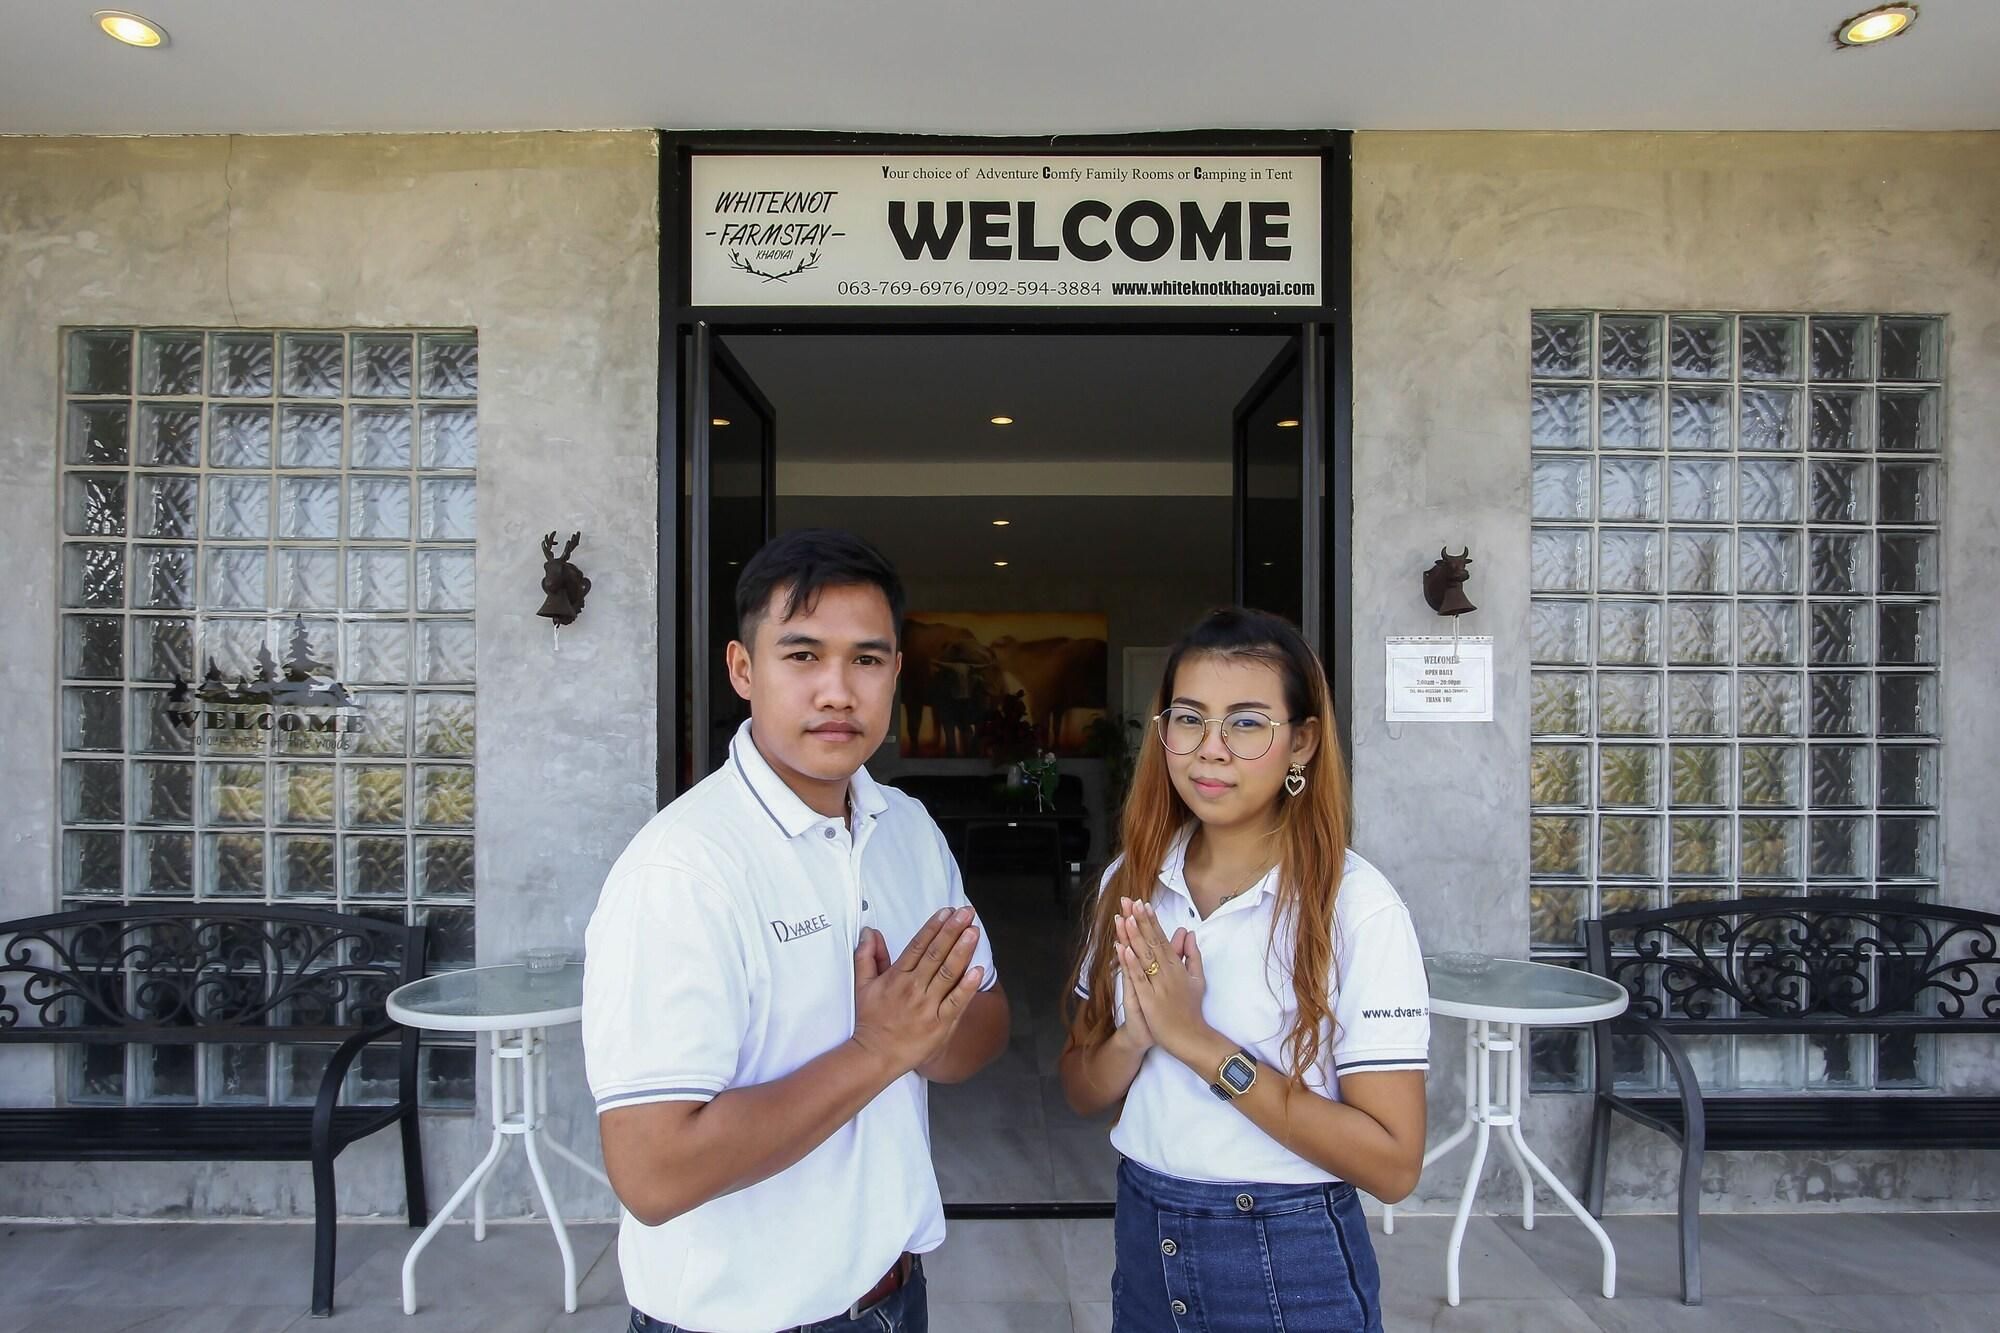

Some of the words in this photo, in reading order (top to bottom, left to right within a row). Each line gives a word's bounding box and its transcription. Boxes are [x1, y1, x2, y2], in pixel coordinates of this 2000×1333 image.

[882, 166, 909, 179] Your
[913, 168, 951, 179] choice
[956, 168, 970, 179] of
[976, 168, 1039, 179] Adventure
[1042, 166, 1082, 182] Comfy
[1086, 168, 1128, 182] Family
[1132, 168, 1174, 179] Rooms
[1178, 171, 1190, 179] or
[1193, 167, 1246, 182] Camping
[1250, 168, 1261, 179] in
[1266, 168, 1293, 179] Tent
[715, 191, 838, 213] WHITEKNOT
[888, 200, 1292, 262] WELCOME
[756, 250, 794, 260] KHAOYAI
[838, 281, 1102, 298] 063-769-6976/092-594-3884
[1112, 280, 1315, 296] www.whiteknotkhaoyai.com
[1424, 656, 1458, 665] WELCOME
[166, 710, 367, 733] WELCOME
